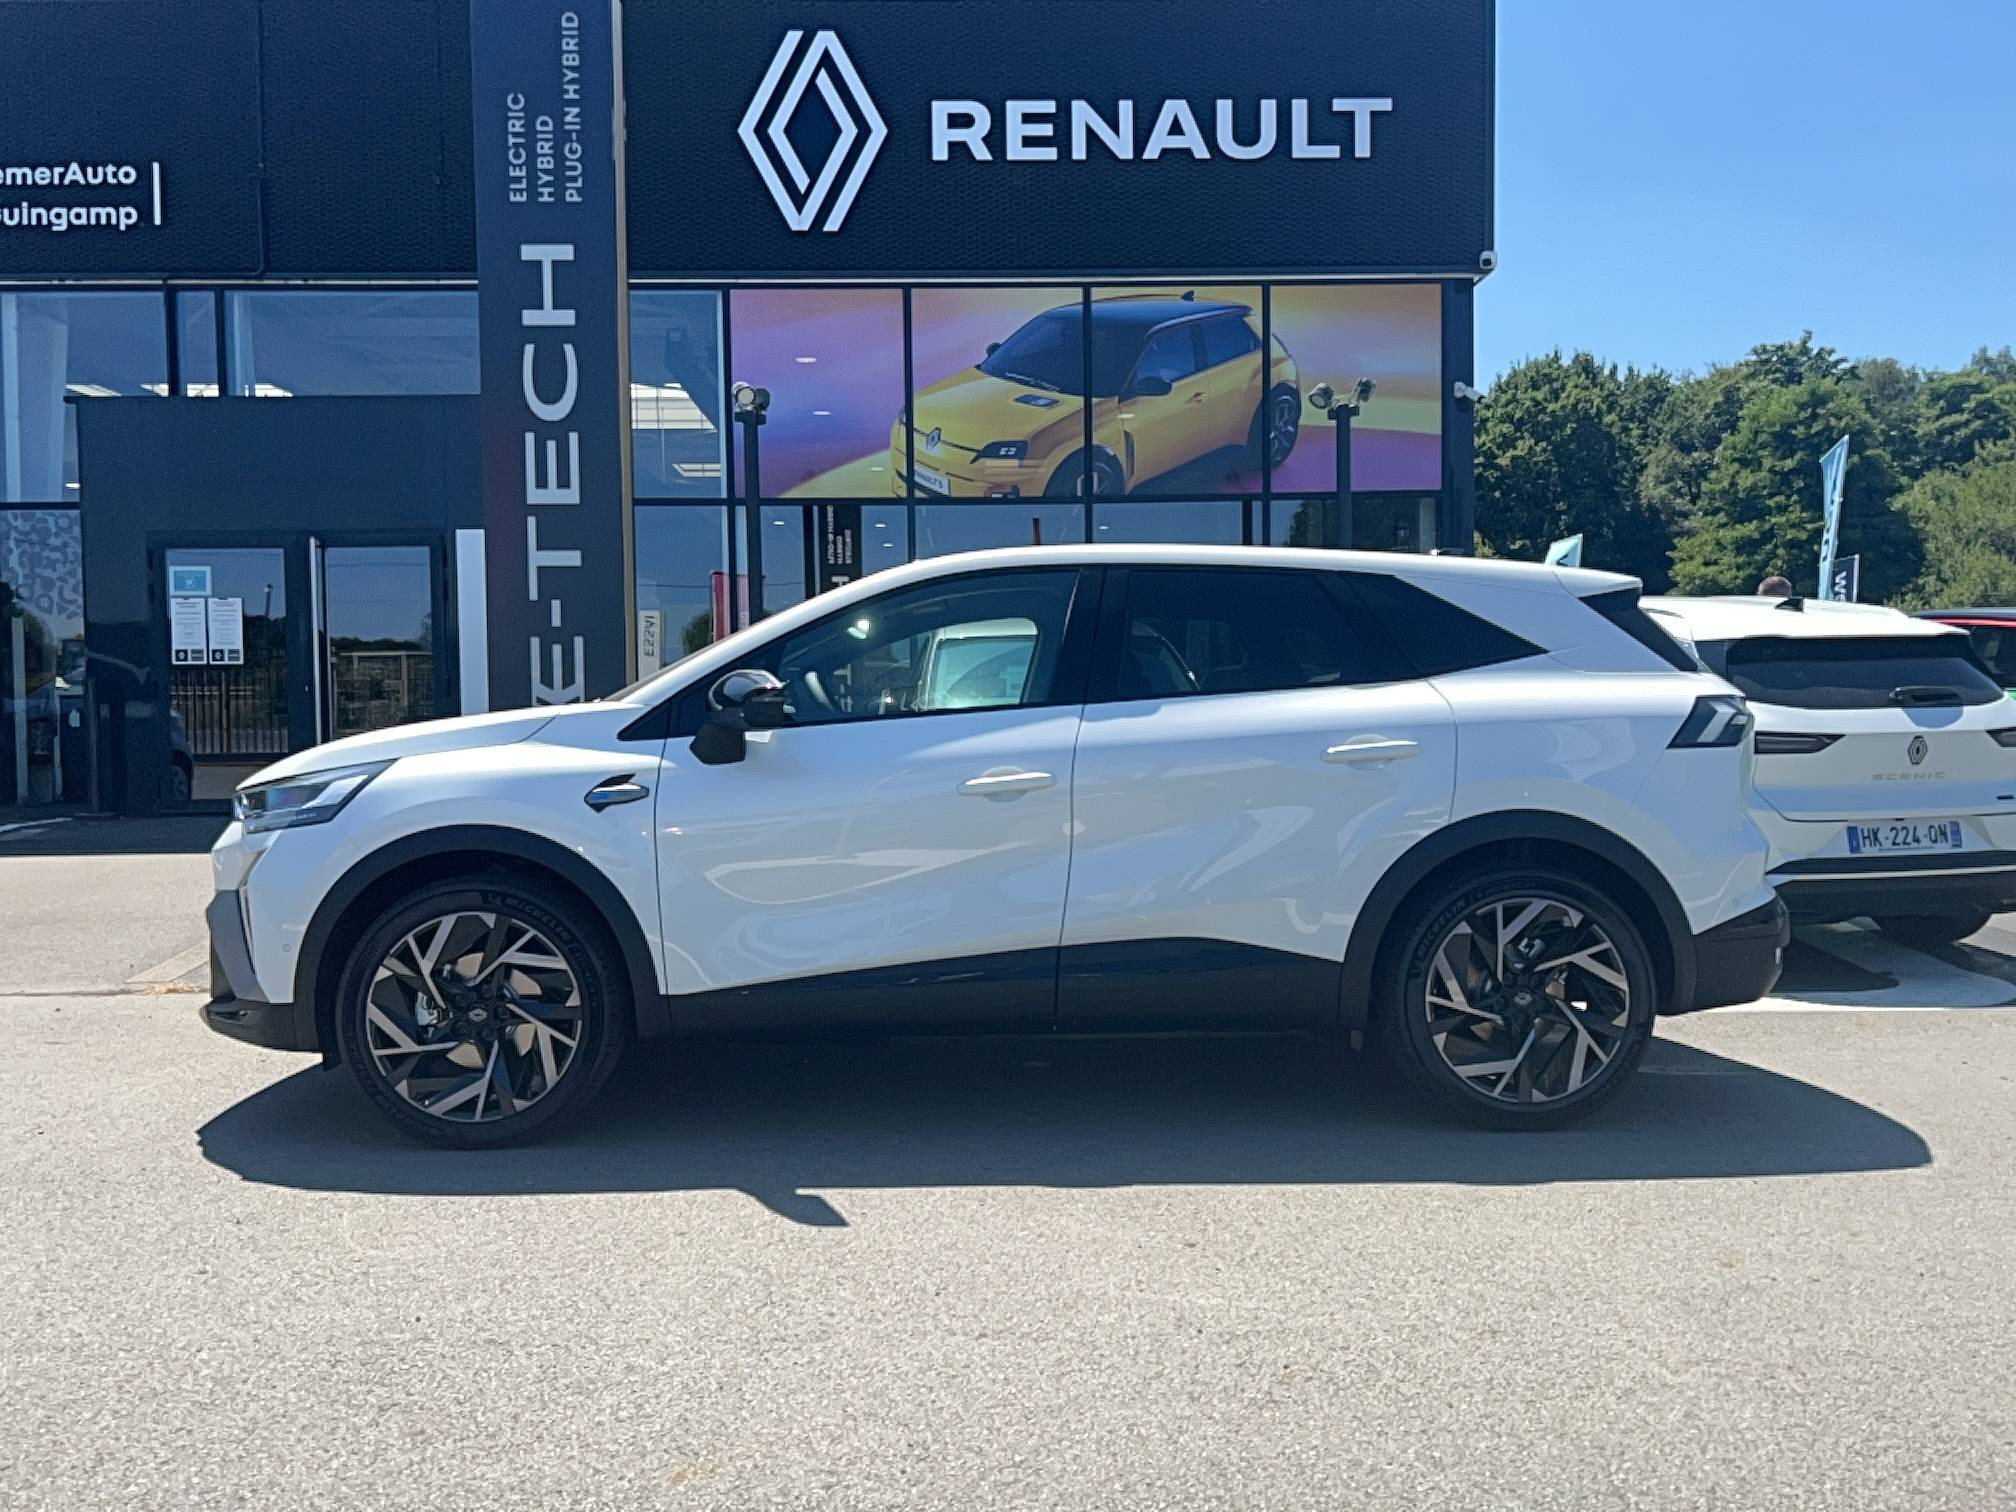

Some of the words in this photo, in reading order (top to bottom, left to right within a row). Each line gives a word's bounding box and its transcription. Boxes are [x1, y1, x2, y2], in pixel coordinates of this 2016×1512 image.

[560, 11, 581, 100] HYBRID
[0, 161, 138, 186] merAuto
[507, 92, 528, 203] ELECTRIC
[535, 115, 555, 203] HYBRID
[563, 106, 583, 203] PLUG-IN
[930, 97, 1393, 162] RENAULT
[0, 201, 138, 232] uingamp
[519, 242, 585, 707] E-TECH
[1872, 771, 1947, 781] SCENIC
